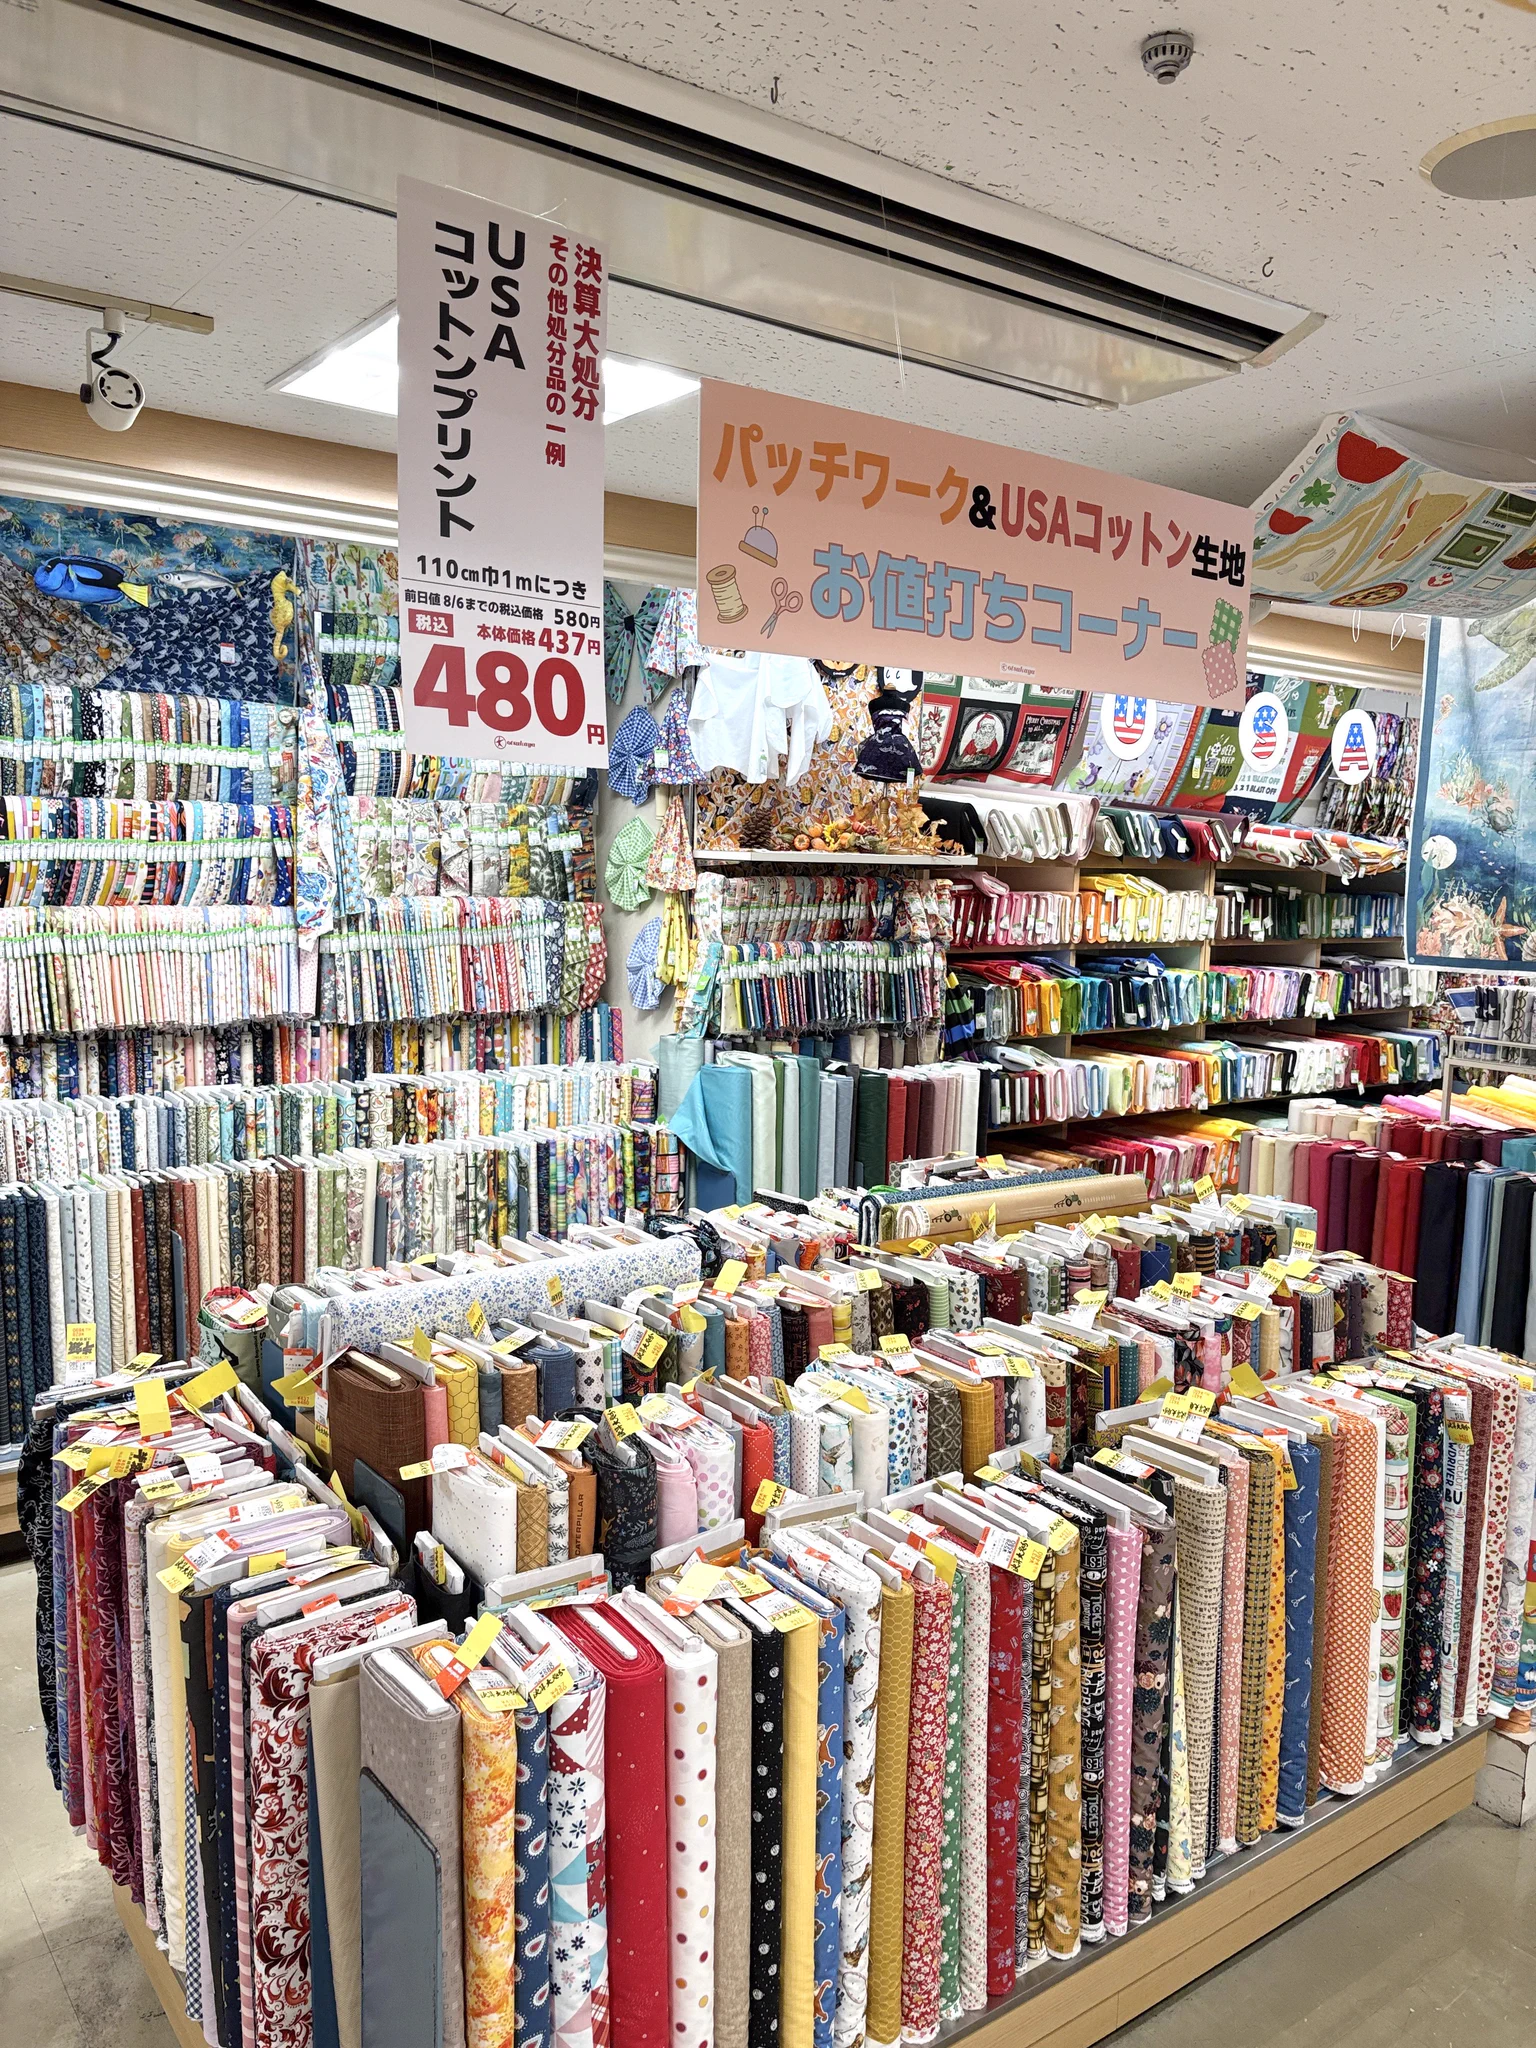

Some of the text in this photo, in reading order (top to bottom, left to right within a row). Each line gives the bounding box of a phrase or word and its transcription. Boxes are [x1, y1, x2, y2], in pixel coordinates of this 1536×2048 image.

[484, 221, 526, 370] USA
[545, 234, 568, 468] その他処分品の一例
[572, 243, 603, 422] 決算大処分
[433, 221, 479, 538] コットンプリント
[713, 422, 1246, 589] パッチワーク&USAコットン生地
[417, 555, 587, 601] 110cm巾1mにつき
[810, 542, 1198, 660] お値打ちコーナー
[415, 614, 449, 634] 税込
[554, 608, 600, 629] 580円
[413, 644, 605, 746] 480円
[1114, 694, 1147, 744] U
[1252, 705, 1278, 759] S
[1339, 723, 1369, 771] A
[1249, 784, 1265, 793] BLAST
[67, 1340, 94, 1354] 半額
[1445, 1442, 1456, 1486] WDRIVER
[1454, 1444, 1466, 1491] struction
[574, 1493, 583, 1555] CATERPILLAR
[1082, 1555, 1106, 1567] BEST
[1090, 1593, 1101, 1635] TICKET
[1444, 1578, 1455, 1641] construction
[1086, 1794, 1098, 1837] TICKET
